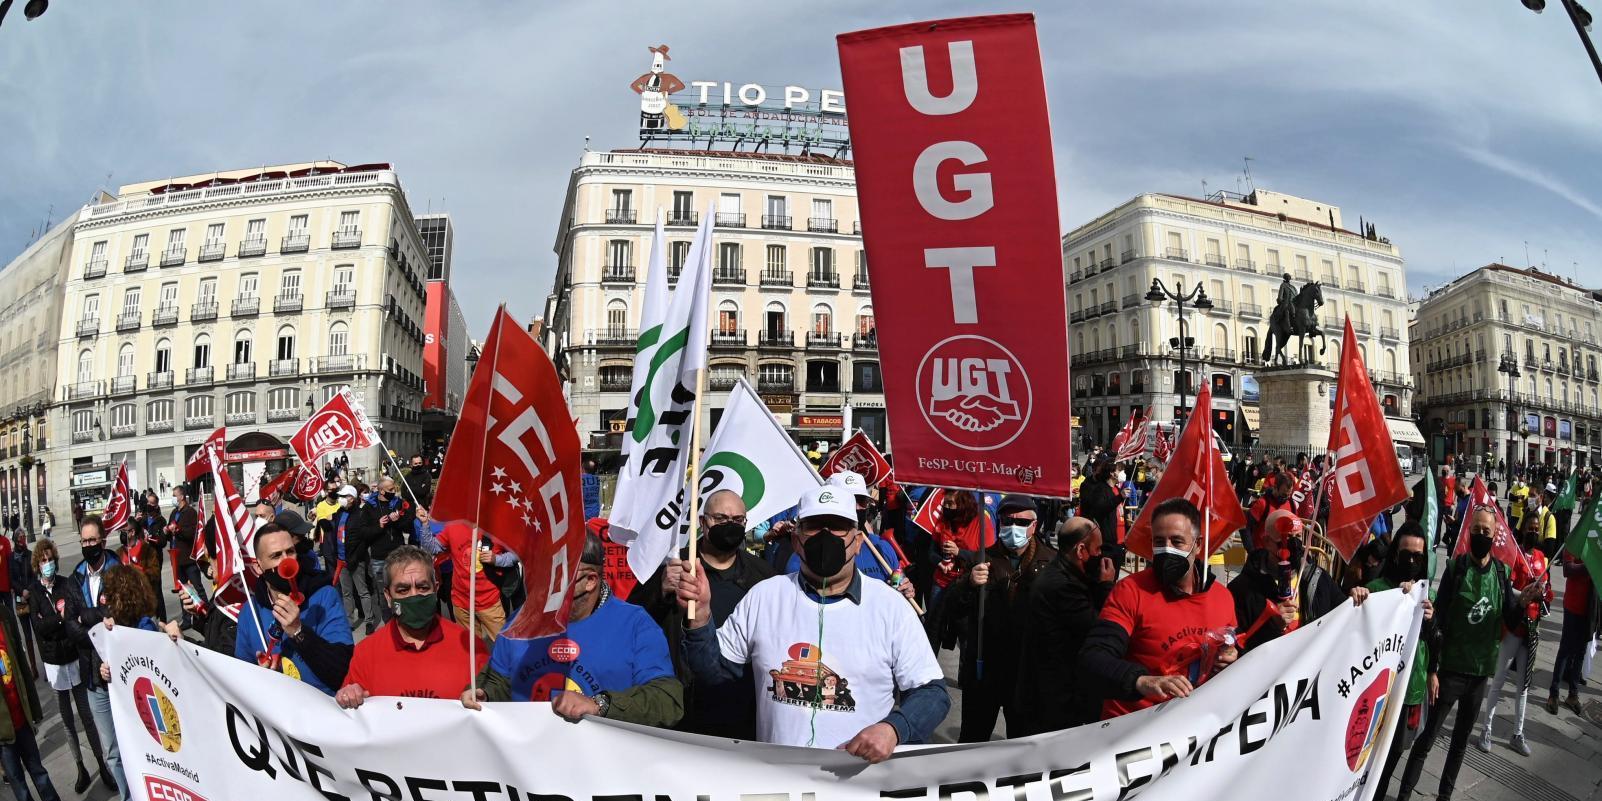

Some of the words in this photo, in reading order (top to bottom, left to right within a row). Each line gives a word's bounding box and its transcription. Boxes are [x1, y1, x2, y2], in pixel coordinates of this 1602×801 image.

[692, 81, 766, 106] TIO
[899, 40, 996, 324] UGT
[932, 357, 1012, 401] UGT
[309, 415, 347, 455] UGT
[825, 703, 856, 713] IFEMA
[145, 753, 200, 784] #ActivaMadrid
